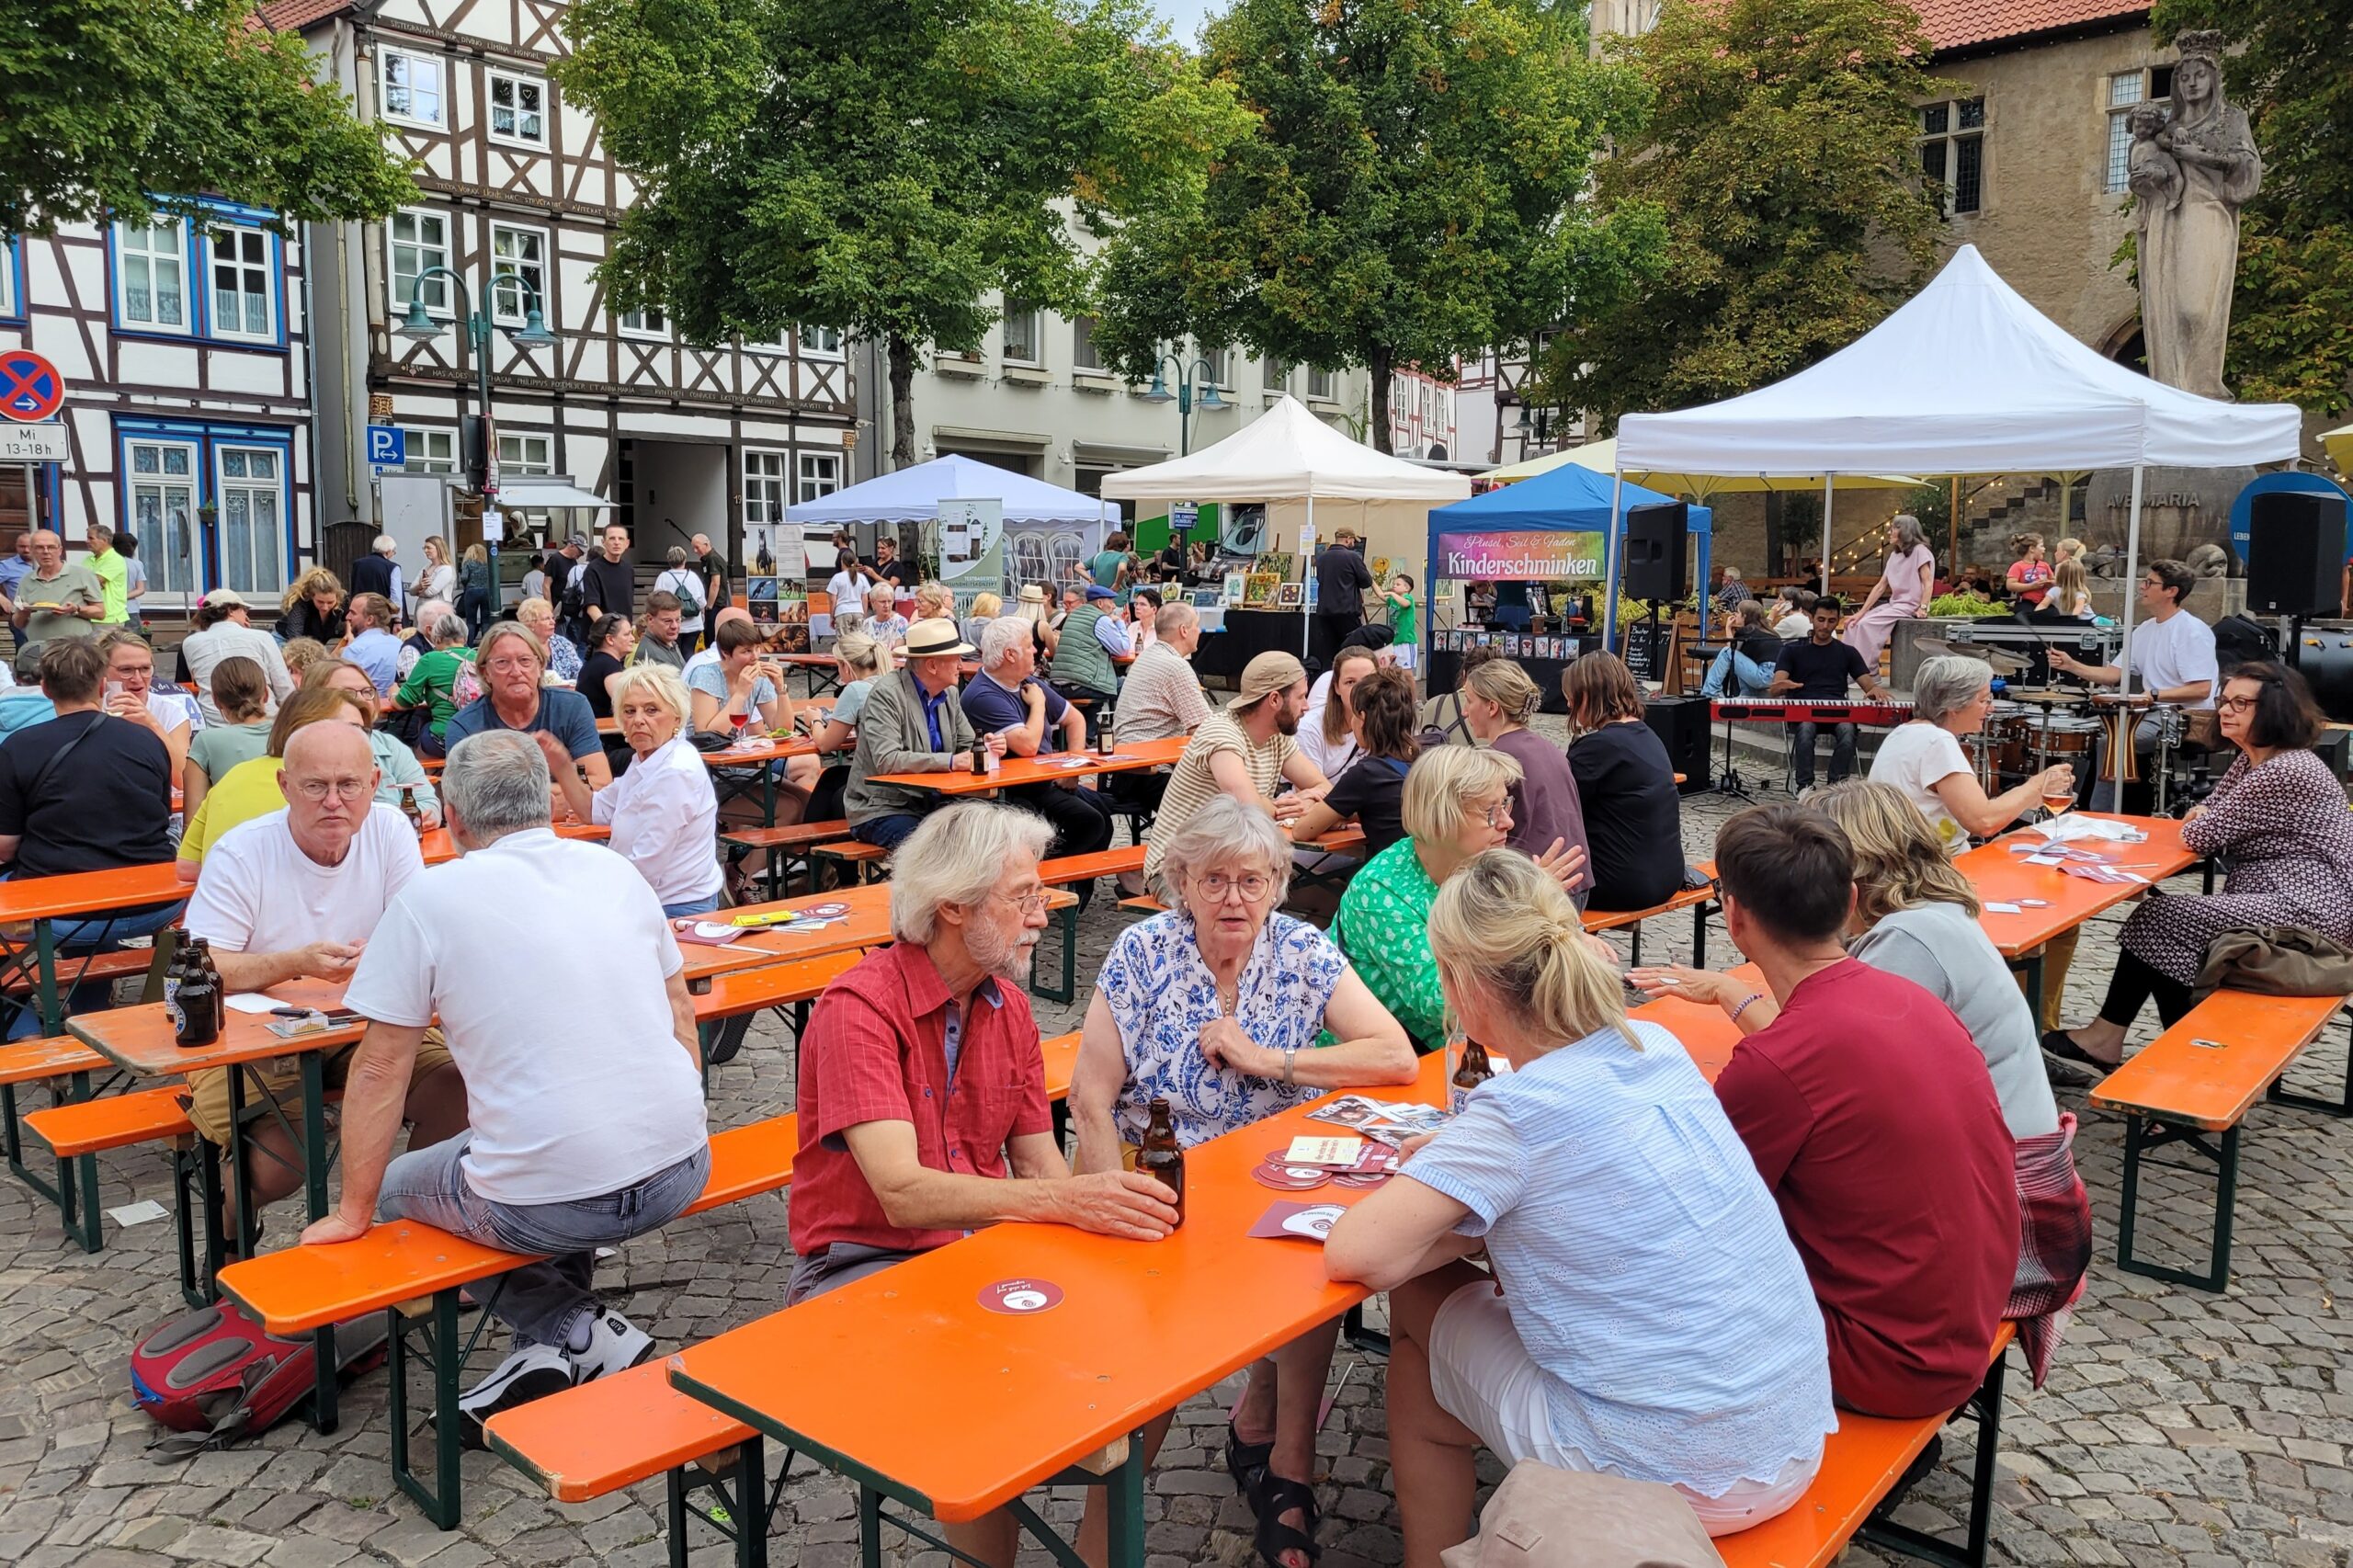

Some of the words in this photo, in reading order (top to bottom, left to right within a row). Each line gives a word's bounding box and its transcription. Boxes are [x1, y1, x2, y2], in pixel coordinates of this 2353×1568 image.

[19, 428, 36, 440] Mi
[6, 443, 43, 455] 13-18
[45, 444, 51, 455] h
[372, 430, 393, 459] P
[2142, 491, 2200, 507] MARIA
[1529, 536, 1541, 549] &
[1543, 534, 1576, 548] Faden
[1448, 551, 1597, 575] Kinderschminken
[609, 1320, 625, 1332] AIR
